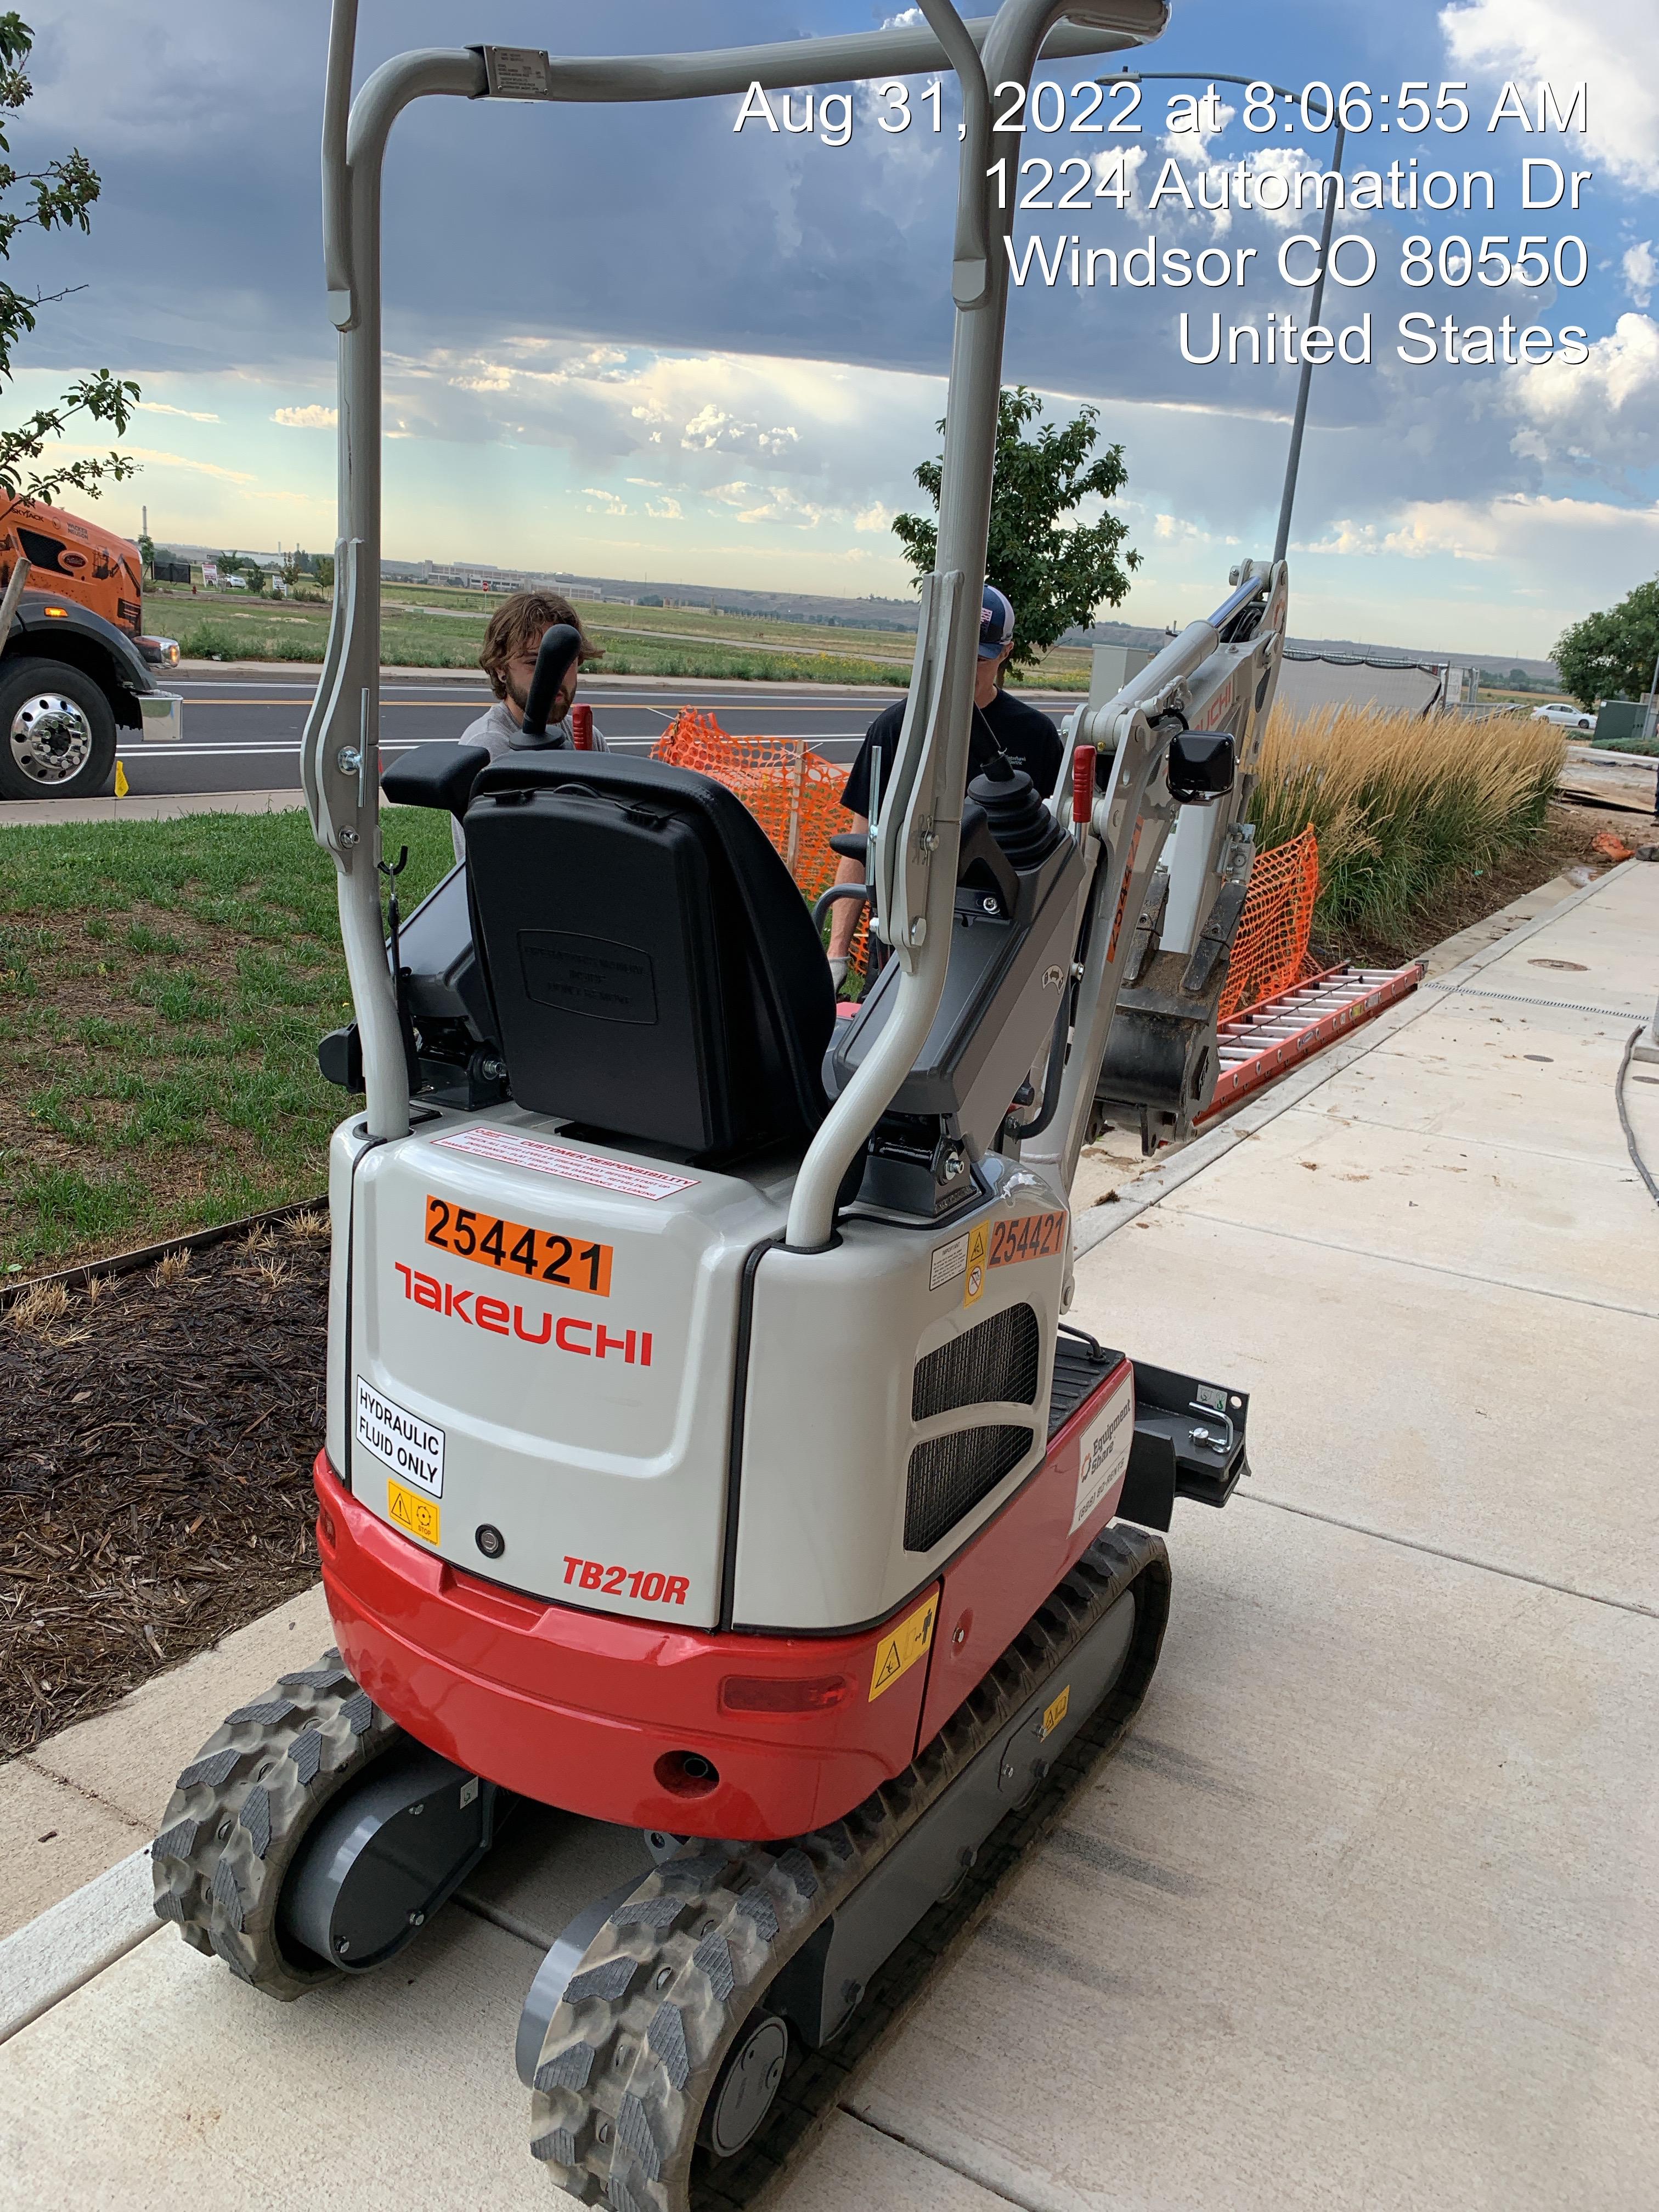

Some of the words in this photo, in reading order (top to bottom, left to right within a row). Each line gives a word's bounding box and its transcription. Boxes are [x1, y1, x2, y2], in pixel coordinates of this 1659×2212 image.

[518, 1141, 588, 1159] CUSTOMER
[585, 1157, 693, 1185] RESPONSIBILITY
[552, 1158, 584, 1167] GREASE
[603, 1171, 634, 1180] BEFORE
[428, 1200, 601, 1291] 254421
[989, 1212, 1064, 1266] 254421
[360, 1387, 439, 1455] HYDRAULIC
[1093, 1398, 1131, 1457] Equipment
[359, 1415, 393, 1457] FLUID
[397, 1447, 438, 1483] ONLY
[1091, 1441, 1114, 1476] Share
[418, 1525, 431, 1536] STOP
[564, 1556, 690, 1606] TB210R
